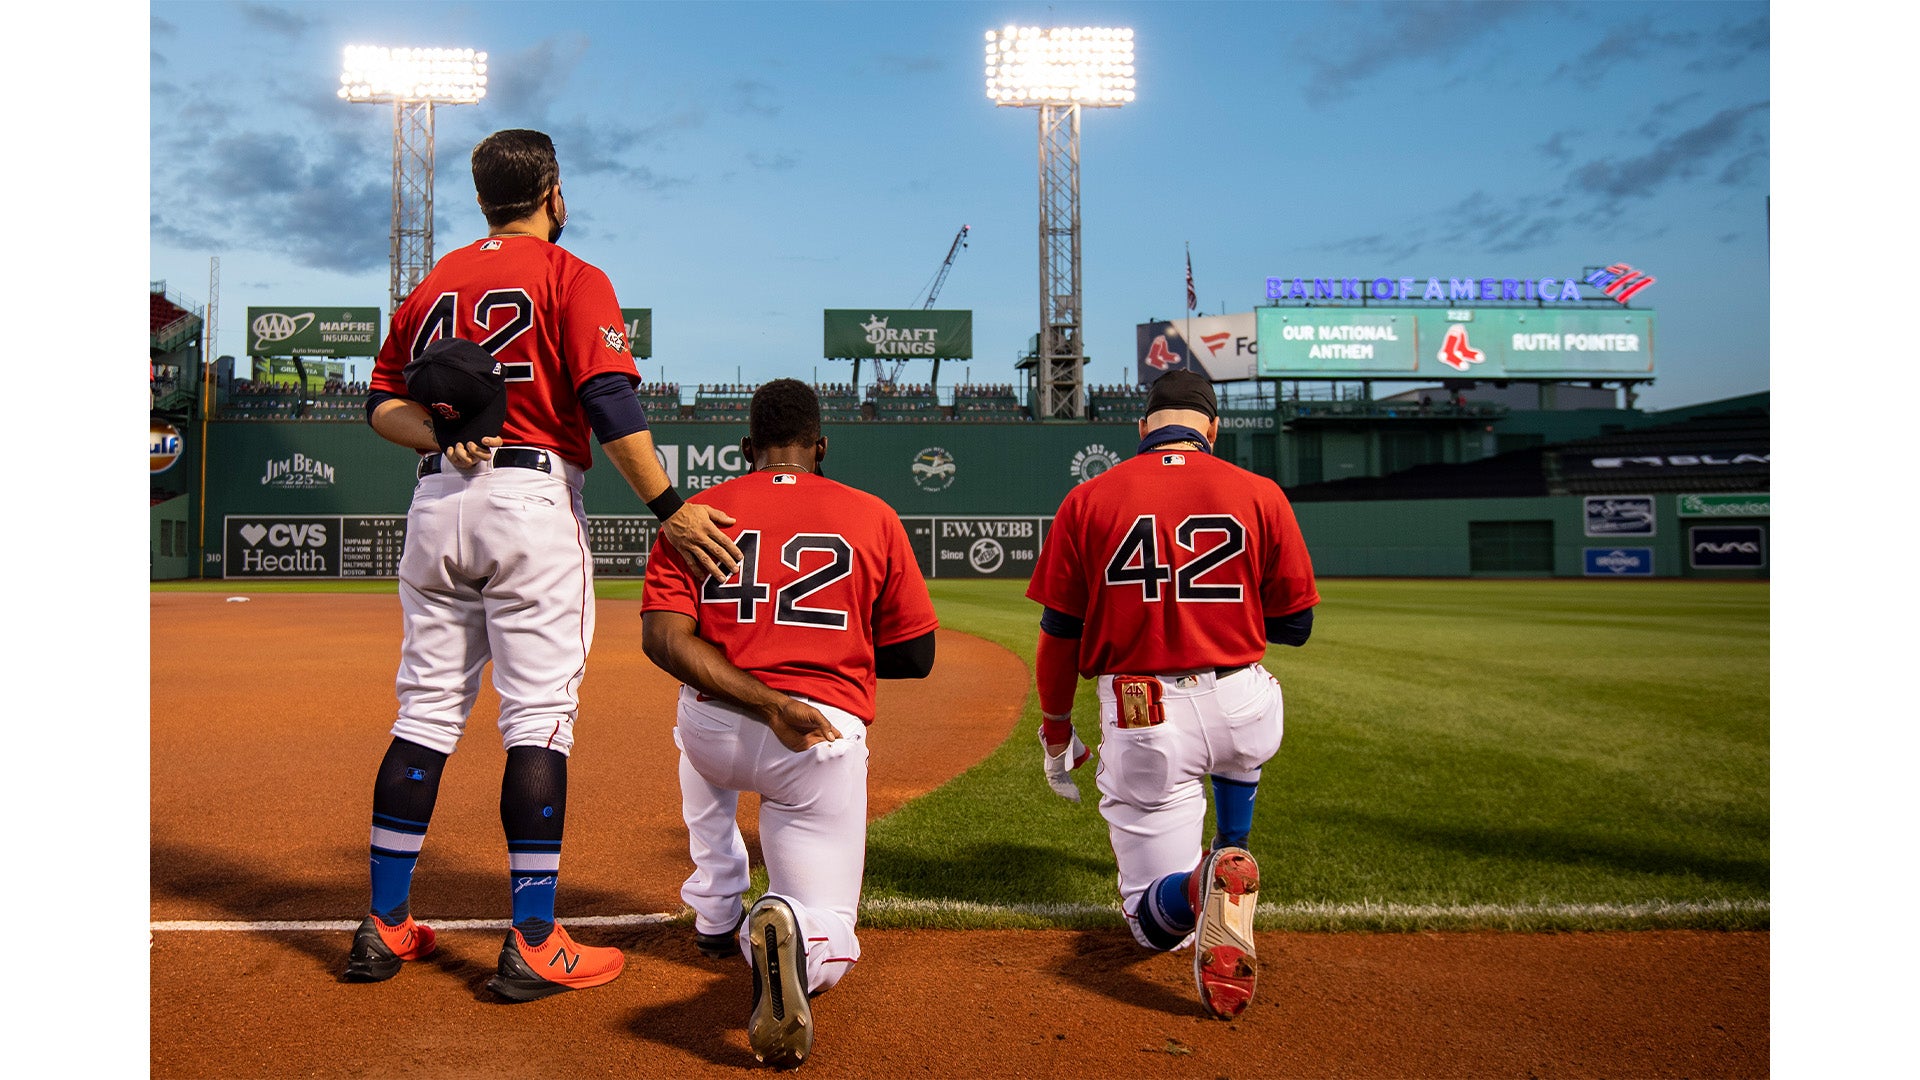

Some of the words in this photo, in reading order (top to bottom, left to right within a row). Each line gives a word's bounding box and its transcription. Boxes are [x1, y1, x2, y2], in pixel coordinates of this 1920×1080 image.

[1265, 276, 1361, 300] BANK
[1371, 276, 1415, 300] OF
[1423, 277, 1582, 301] AMERICA
[256, 314, 293, 339] AAA
[320, 321, 375, 332] MAPFRE
[411, 287, 534, 382] 42
[1282, 325, 1314, 341] OUR
[1319, 325, 1398, 341] NATIONAL
[322, 334, 372, 343] INSURANCE
[870, 327, 938, 344] DRAFT
[1512, 333, 1561, 352] RUTH
[1564, 333, 1640, 352] POINTER
[875, 342, 936, 355] KINGS
[1309, 344, 1374, 360] ANTHEM
[262, 459, 290, 484] JIM
[294, 453, 334, 484] BEAM
[285, 474, 314, 485] 225
[687, 475, 742, 489] RES
[268, 523, 327, 547] CVS
[942, 522, 976, 538] F.W.
[977, 522, 1033, 538] WEBB
[206, 553, 221, 563] 310
[242, 549, 327, 572] Health
[941, 549, 964, 560] Since
[1011, 550, 1034, 560] 1866
[1105, 514, 1246, 602] 42
[701, 530, 853, 630] 42
[548, 947, 580, 974] N
